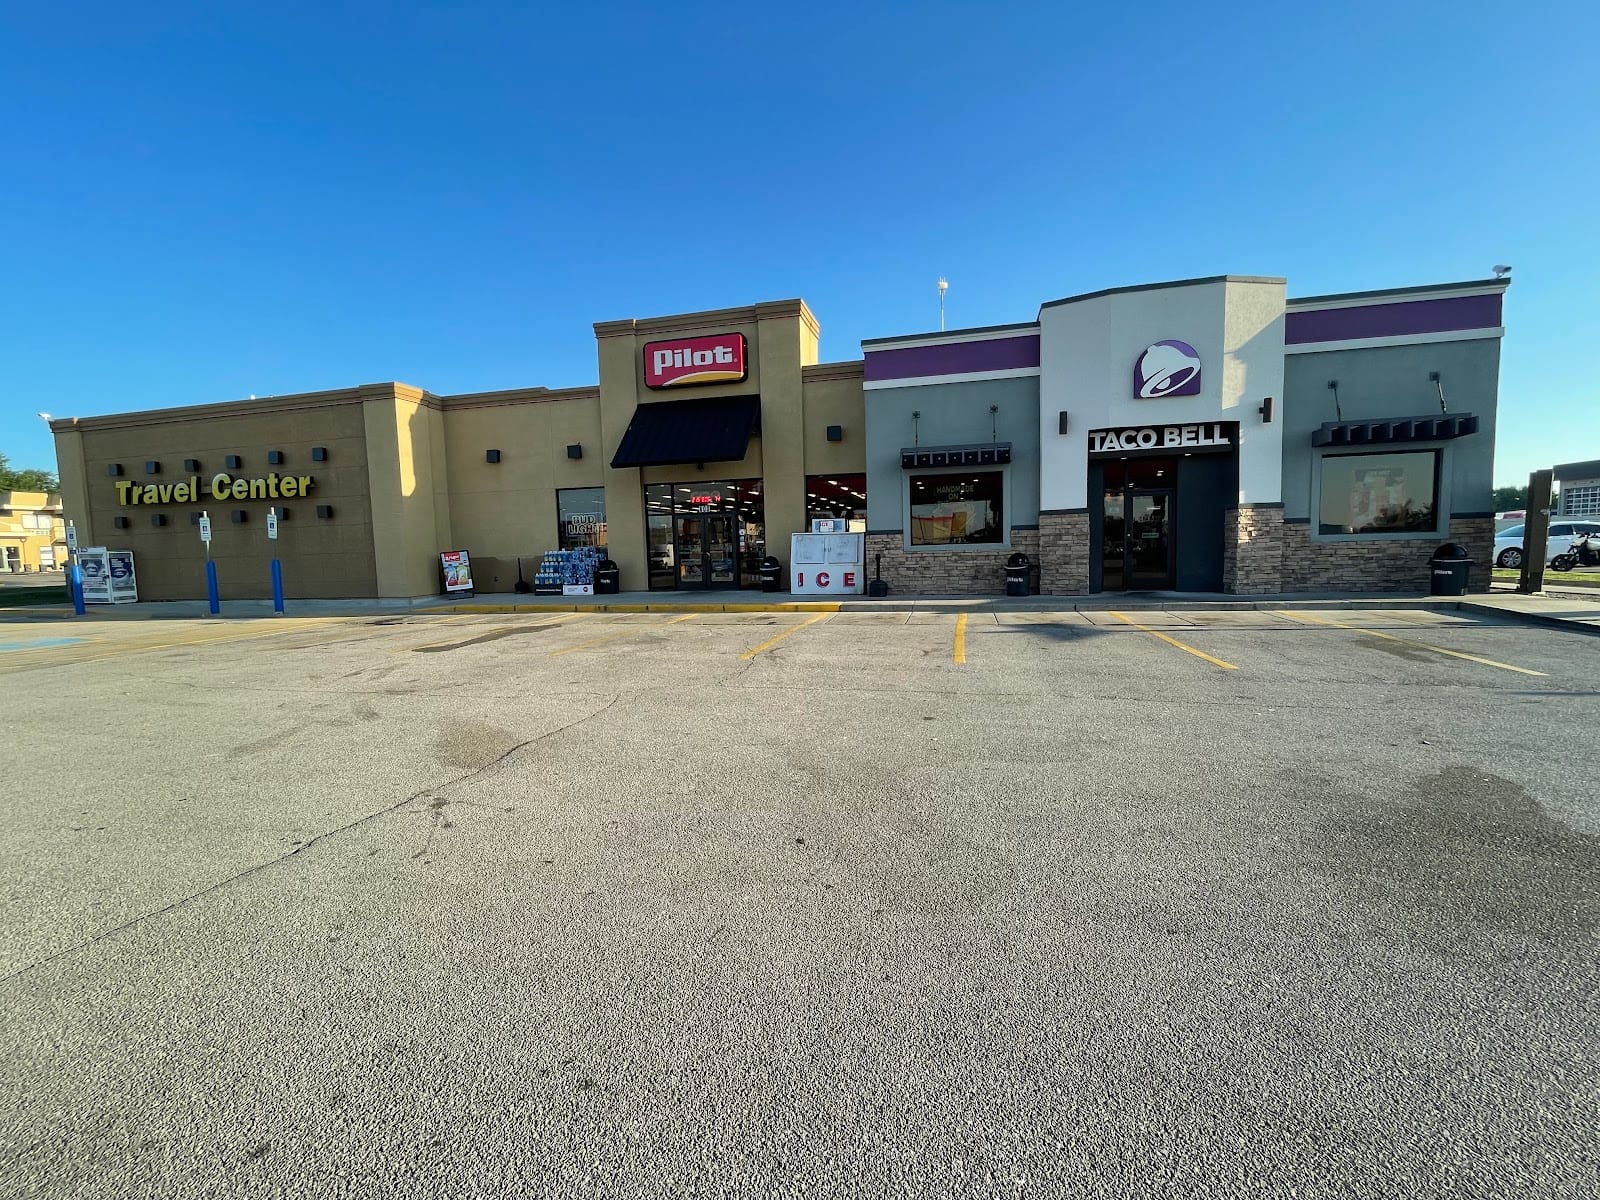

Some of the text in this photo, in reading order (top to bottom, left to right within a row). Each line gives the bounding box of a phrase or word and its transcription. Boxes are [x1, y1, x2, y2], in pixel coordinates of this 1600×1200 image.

[1089, 424, 1231, 452] TACO BELL
[115, 472, 313, 506] Travel Center
[571, 514, 596, 525] BUD
[568, 523, 600, 534] LIGHT
[797, 572, 856, 588] ICE
